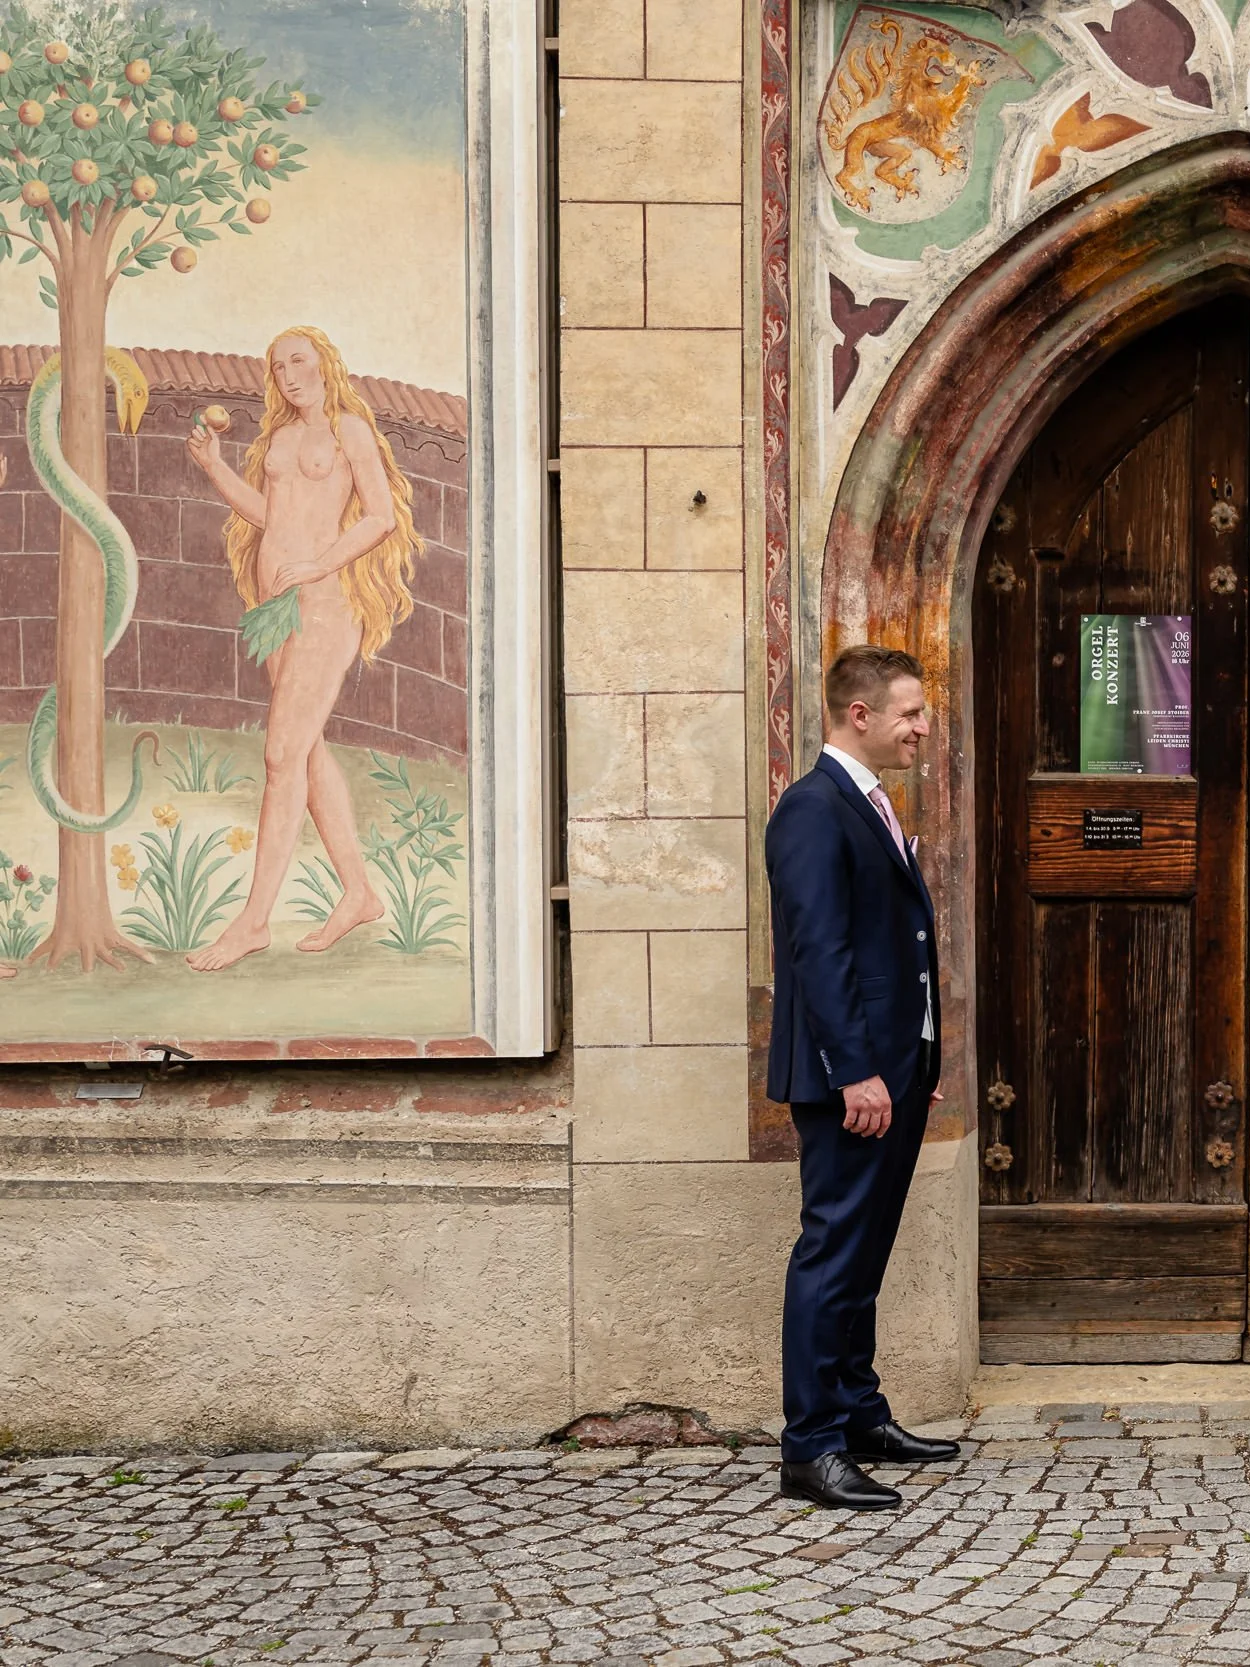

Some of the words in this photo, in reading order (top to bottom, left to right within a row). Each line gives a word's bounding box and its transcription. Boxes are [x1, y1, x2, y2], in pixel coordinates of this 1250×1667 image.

[1174, 631, 1190, 642] 06
[1170, 641, 1189, 649] JUNI
[1091, 625, 1103, 681] ORGEL
[1171, 650, 1190, 658] 2026
[1106, 626, 1119, 705] KONZERT
